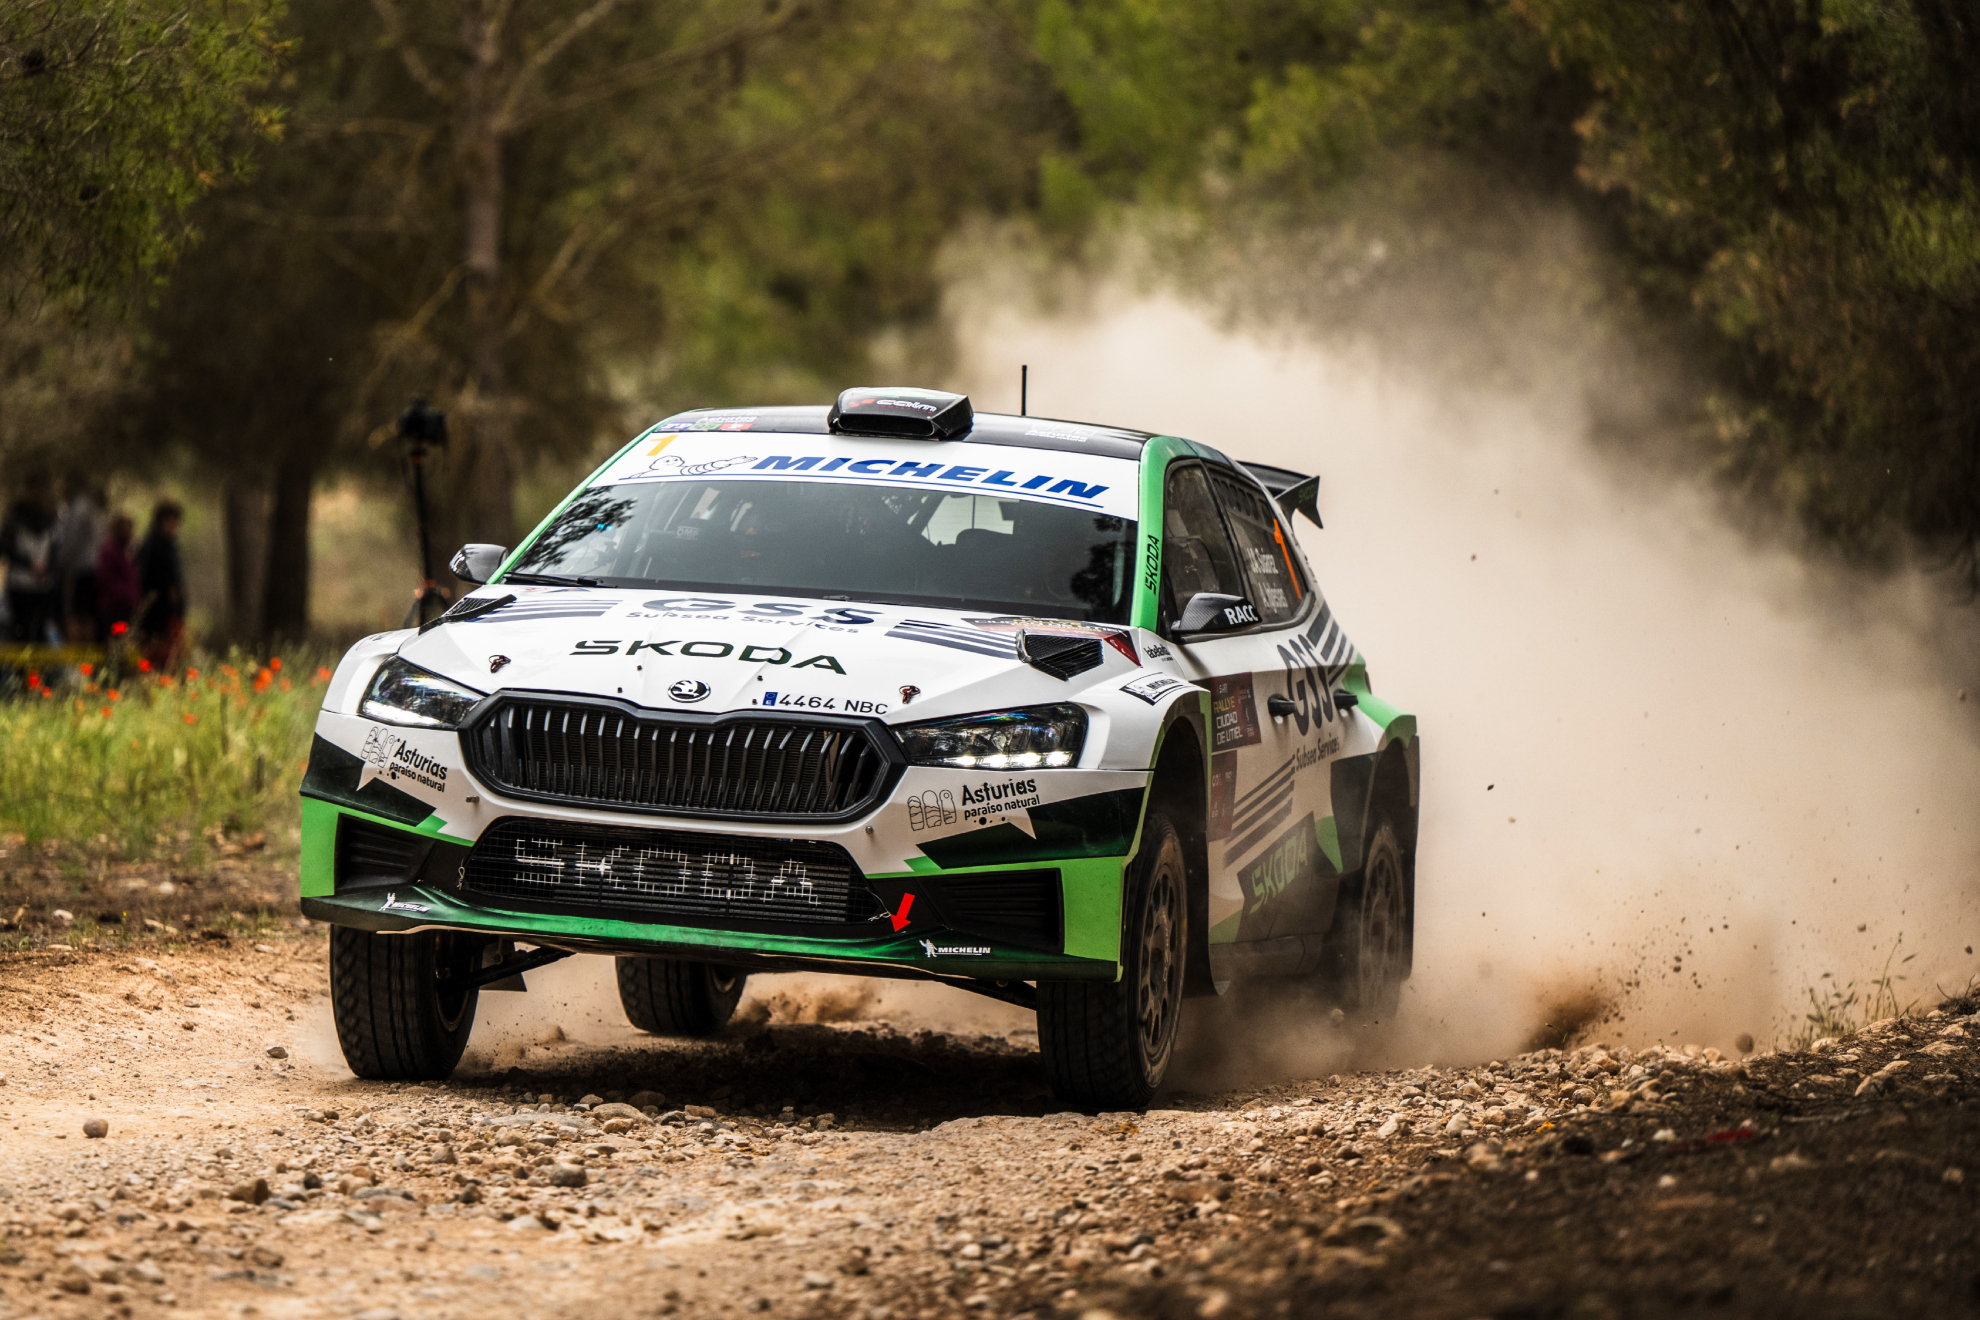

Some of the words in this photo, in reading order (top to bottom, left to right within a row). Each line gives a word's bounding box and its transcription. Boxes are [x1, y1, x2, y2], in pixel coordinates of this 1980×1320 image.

[646, 434, 679, 456] 1
[750, 455, 1109, 499] MICHELIN
[1145, 534, 1160, 596] SKODA
[625, 611, 730, 620] Subsea
[741, 615, 859, 634] Services
[642, 597, 885, 625] GSS
[1224, 605, 1258, 625] RACC
[569, 640, 847, 675] SKODA
[1276, 634, 1334, 736] GSS
[779, 694, 836, 709] 4464
[844, 700, 888, 714] NBC
[1213, 696, 1235, 714] RALLYE
[1216, 711, 1237, 729] CIUDAD
[1217, 731, 1226, 745] DE
[1226, 726, 1243, 741] UTIEL
[393, 740, 448, 780] Asturias
[1296, 745, 1317, 771] Subsea
[1318, 732, 1340, 761] Services
[389, 762, 416, 780] paraíso
[417, 773, 446, 792] natural
[961, 778, 1037, 806] Asturias
[964, 803, 1003, 821] paraíso
[1004, 794, 1041, 811] natural
[513, 838, 820, 905] SKODA
[1249, 827, 1308, 915] SKODA
